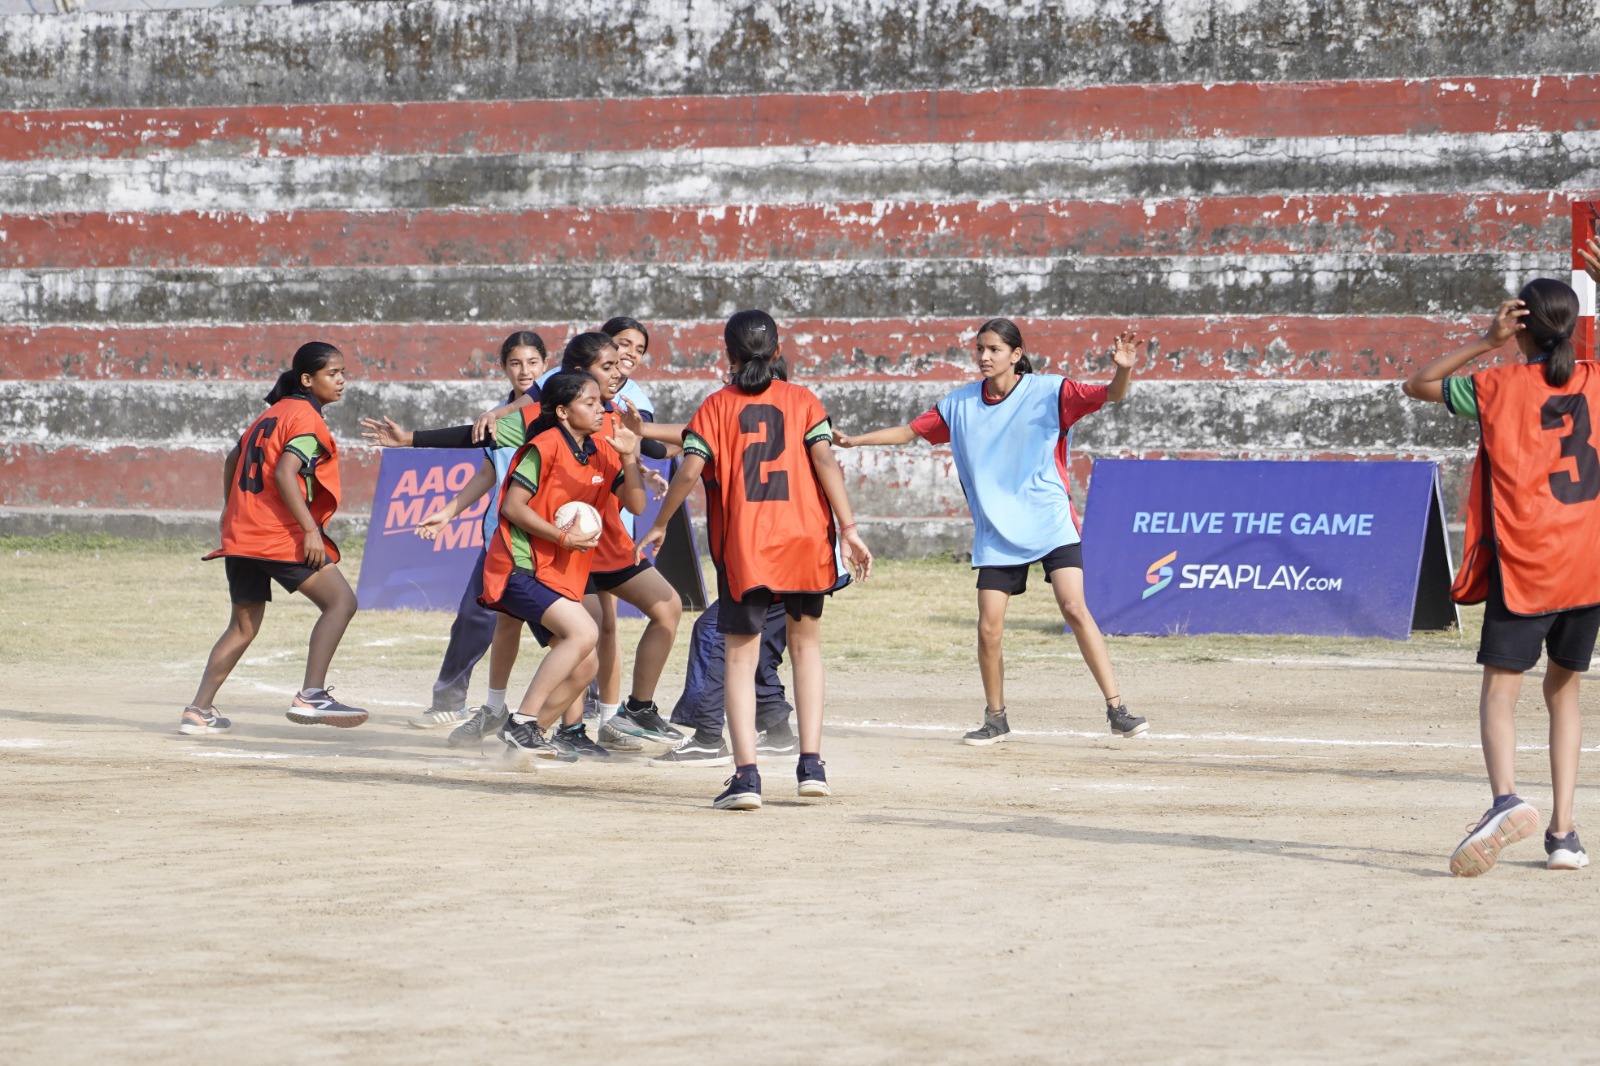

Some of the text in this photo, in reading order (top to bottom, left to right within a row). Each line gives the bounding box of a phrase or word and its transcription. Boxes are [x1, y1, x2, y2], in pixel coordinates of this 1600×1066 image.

[238, 417, 278, 495] 6
[391, 462, 475, 499] AAO
[738, 404, 789, 501] 2
[1540, 393, 1600, 505] 3
[1132, 511, 1374, 536] RELIVE THE GAME
